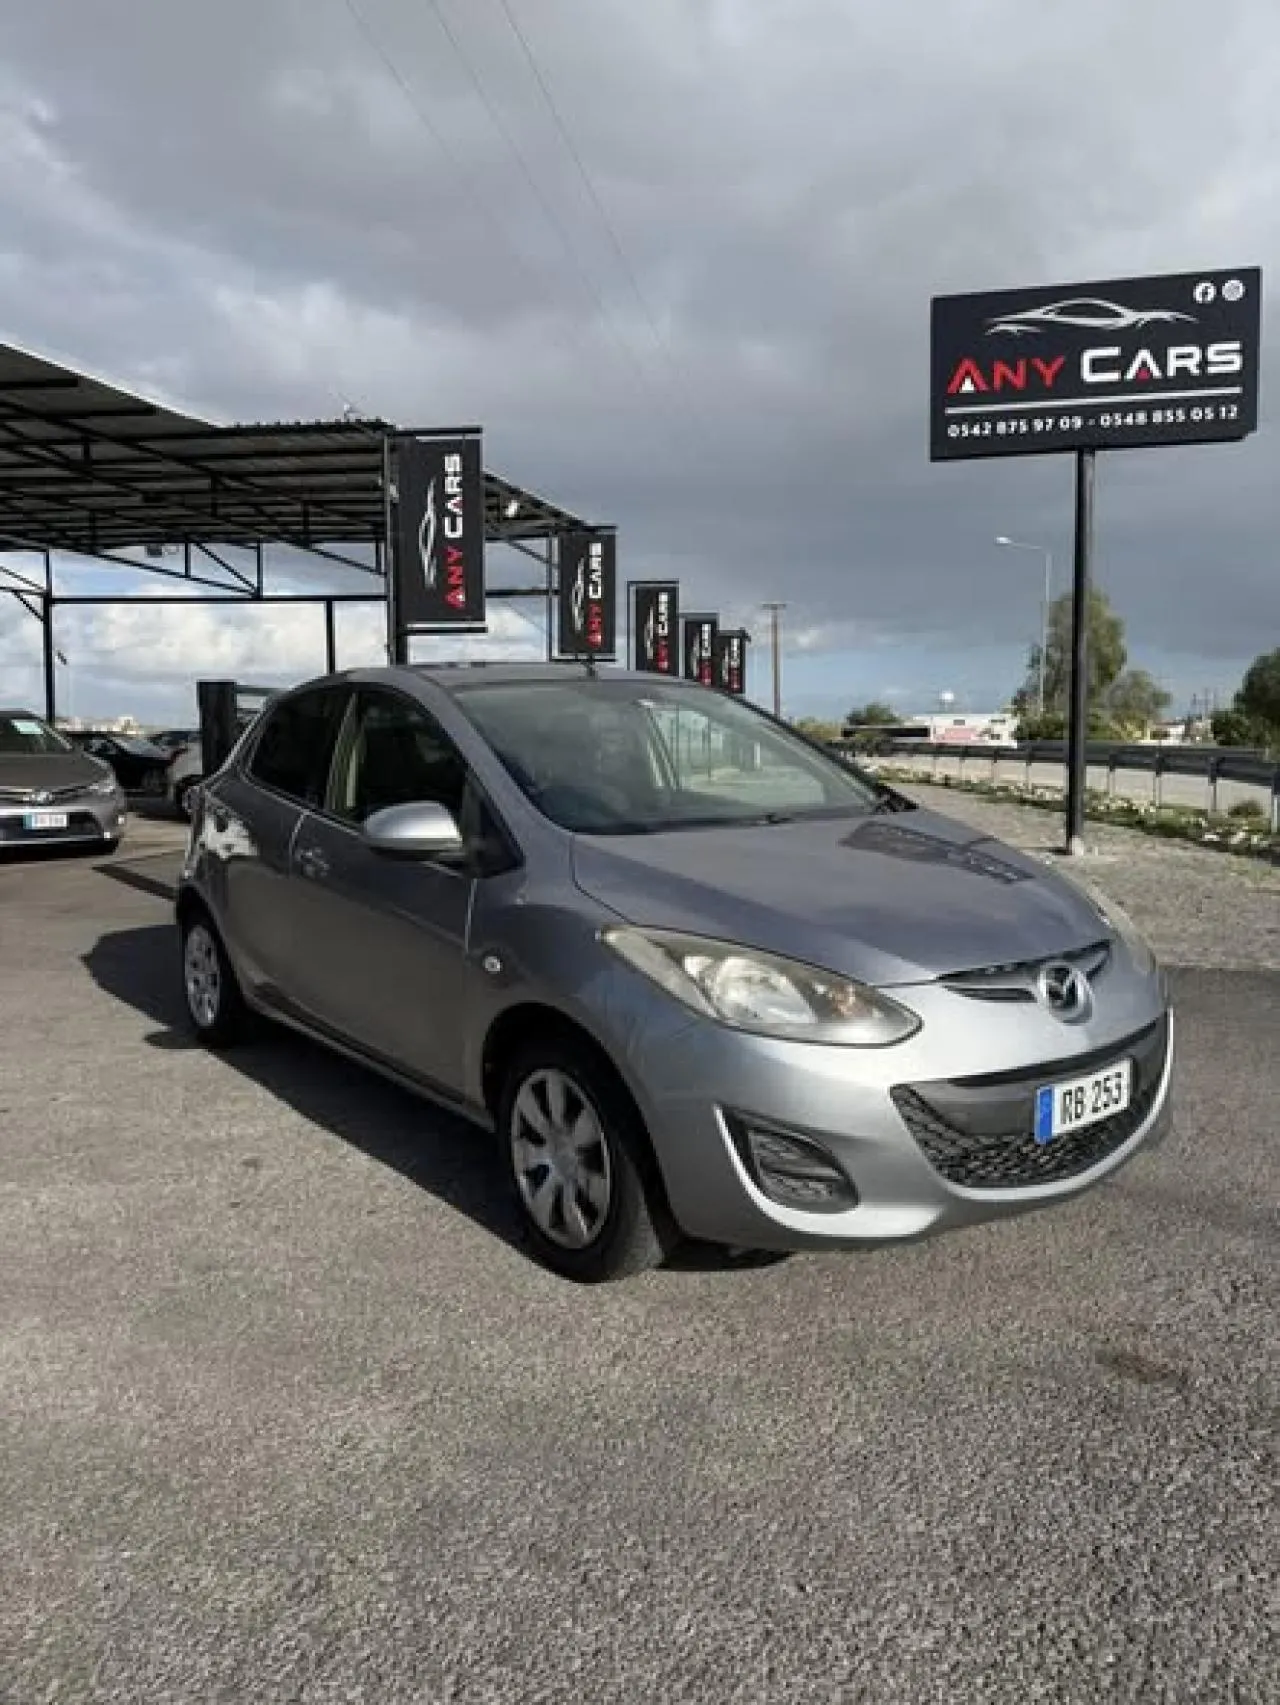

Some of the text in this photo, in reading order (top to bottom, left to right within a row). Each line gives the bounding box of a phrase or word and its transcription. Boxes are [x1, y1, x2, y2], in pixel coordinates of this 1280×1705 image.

[947, 341, 1243, 394] ANY CARS
[1059, 415, 1083, 431] 09
[444, 453, 466, 608] ANY CARS
